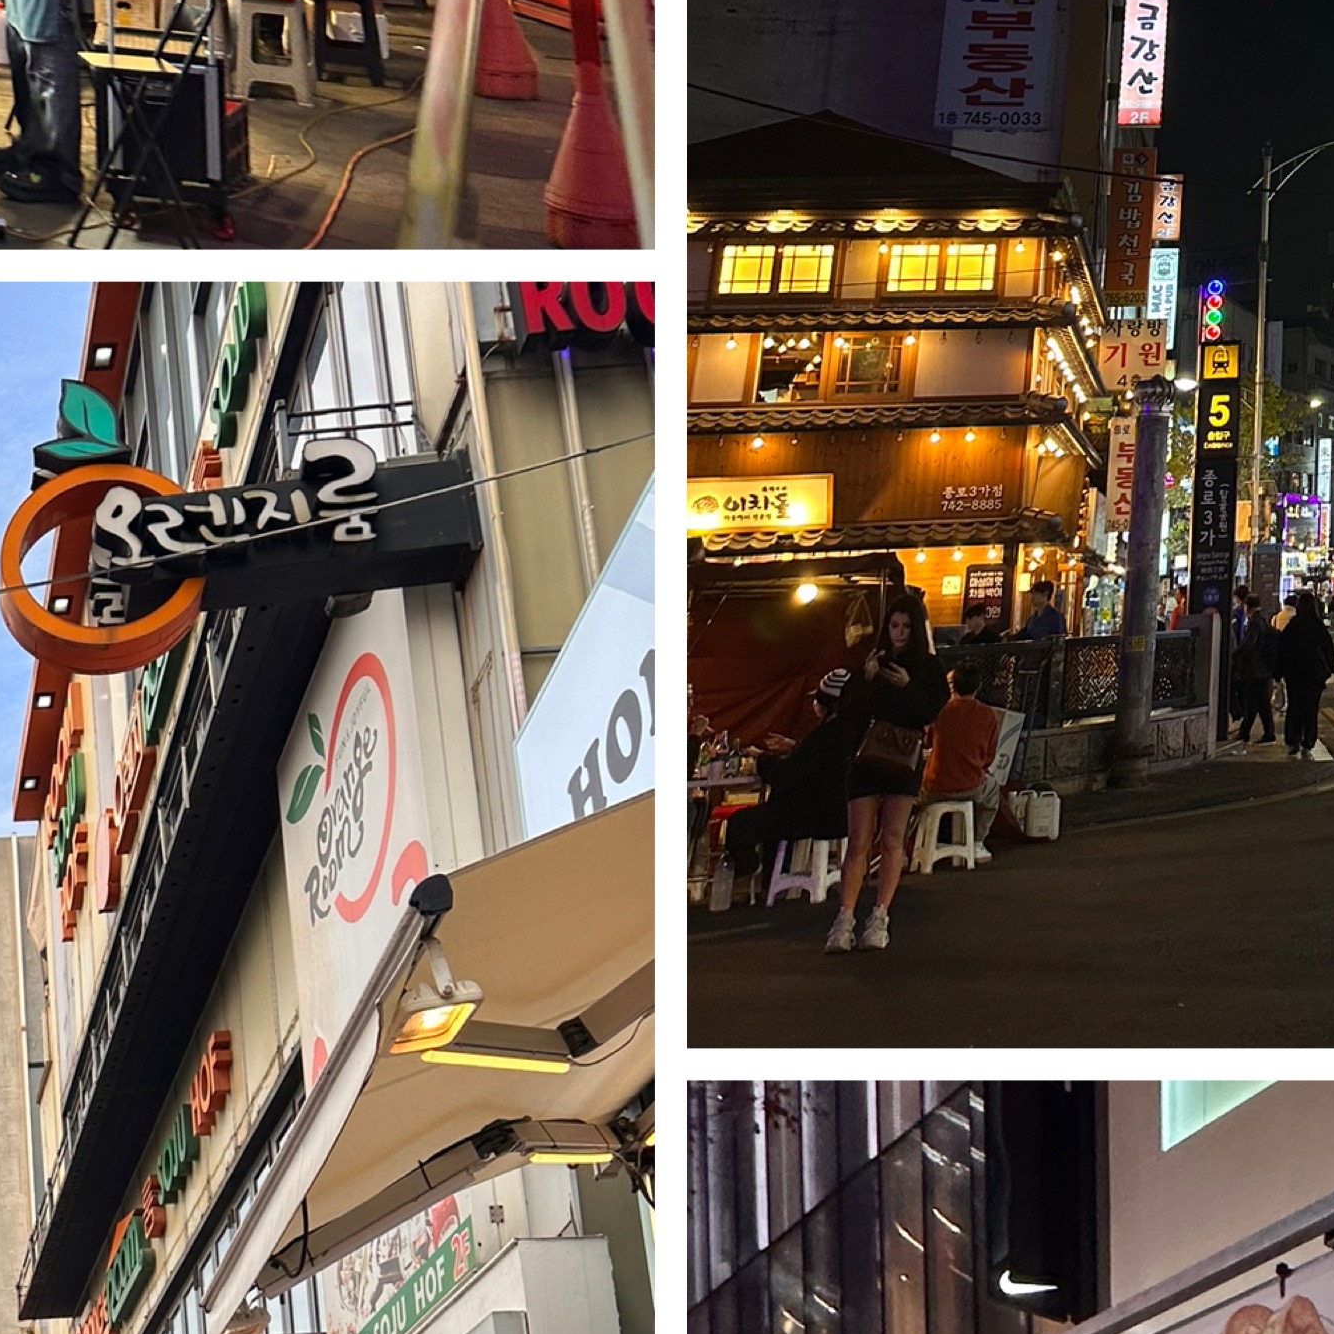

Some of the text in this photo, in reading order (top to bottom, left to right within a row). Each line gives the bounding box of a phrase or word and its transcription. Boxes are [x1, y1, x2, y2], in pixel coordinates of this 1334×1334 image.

[959, 10, 1034, 107] 부동산
[1128, 2, 1160, 95] 금강산
[939, 110, 1042, 127] 1층 745-0033
[1130, 111, 1149, 124] 2F
[1157, 178, 1177, 224] 금강산
[1117, 181, 1142, 286] 김밥천국
[1105, 292, 1145, 303] 765-6203
[1151, 285, 1163, 314] MAC
[1105, 319, 1164, 338] 사랑방
[1103, 342, 1162, 368] 기원
[1208, 394, 1230, 428] 5
[91, 437, 379, 567] 오렌지룸
[723, 493, 790, 519] 이차돌
[941, 499, 1002, 512] 742-8885
[942, 483, 1004, 499] 종로3가점
[1199, 469, 1218, 546] 종로3가
[318, 727, 376, 868] Orange
[413, 1258, 446, 1316] HOF
[453, 1227, 471, 1278] 2F
